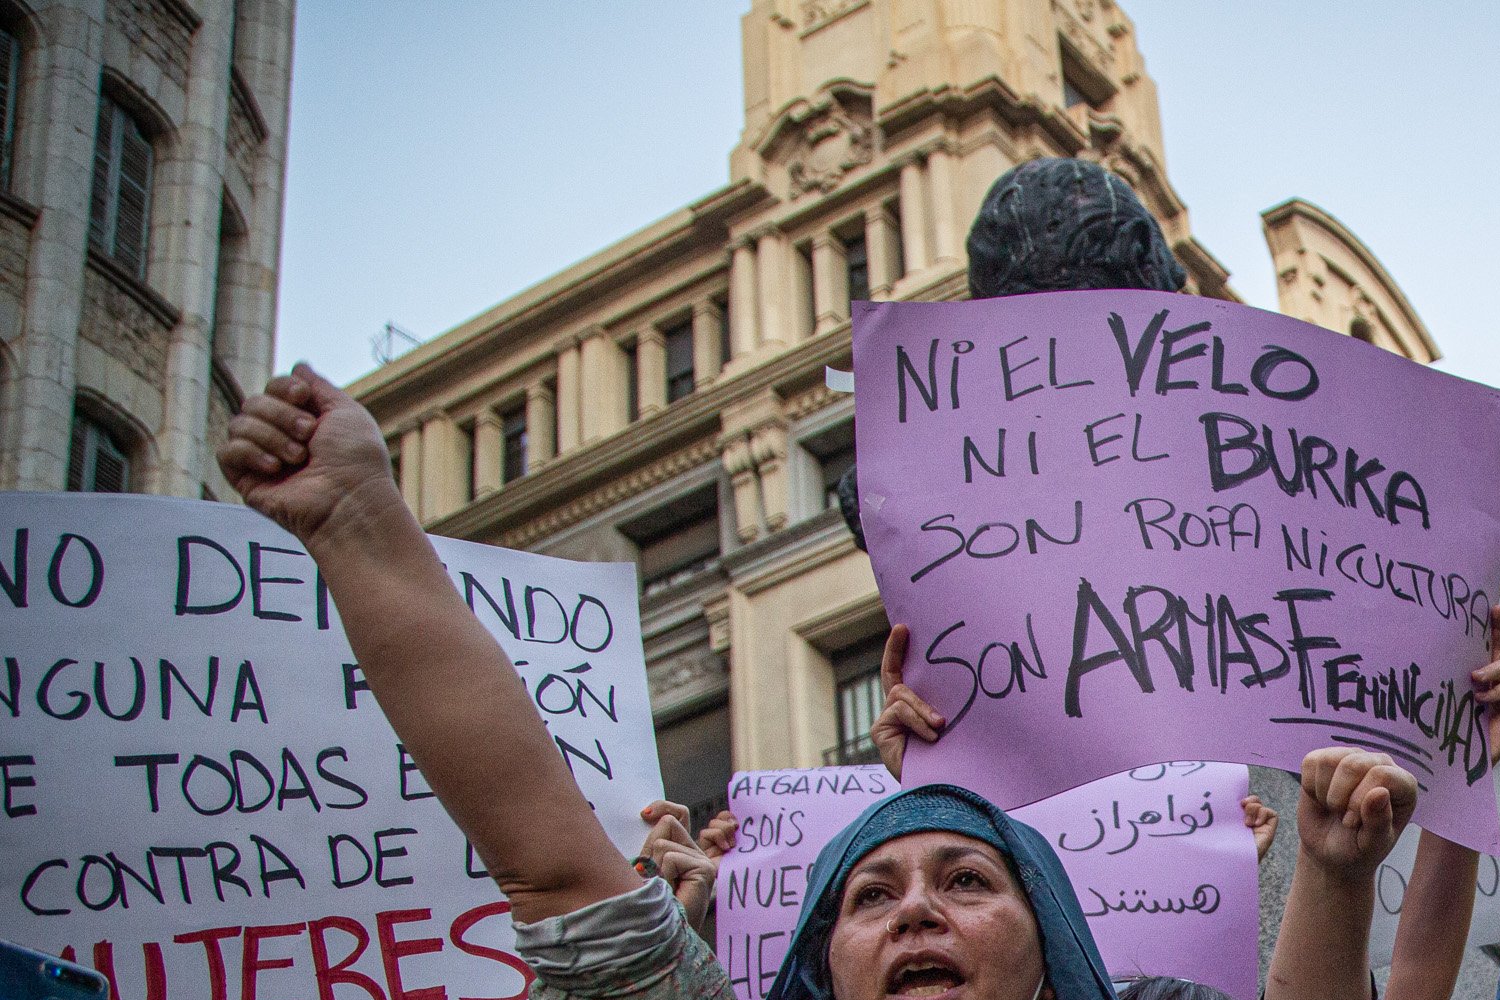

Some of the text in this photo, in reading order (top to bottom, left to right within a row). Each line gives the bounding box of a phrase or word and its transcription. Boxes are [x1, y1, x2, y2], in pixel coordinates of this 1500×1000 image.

[1000, 335, 1095, 401] EL
[1107, 309, 1320, 401] VELO
[1083, 412, 1170, 467] EL
[1199, 412, 1431, 530] BURKA
[910, 500, 1083, 583] SON
[1125, 498, 1261, 552] ROPA
[926, 612, 1048, 739] SON
[1064, 576, 1291, 718] ARMAS
[114, 746, 369, 816] TODAS
[732, 773, 887, 799] AFGANAS
[20, 834, 306, 916] CONTRA
[327, 828, 418, 889] DE
